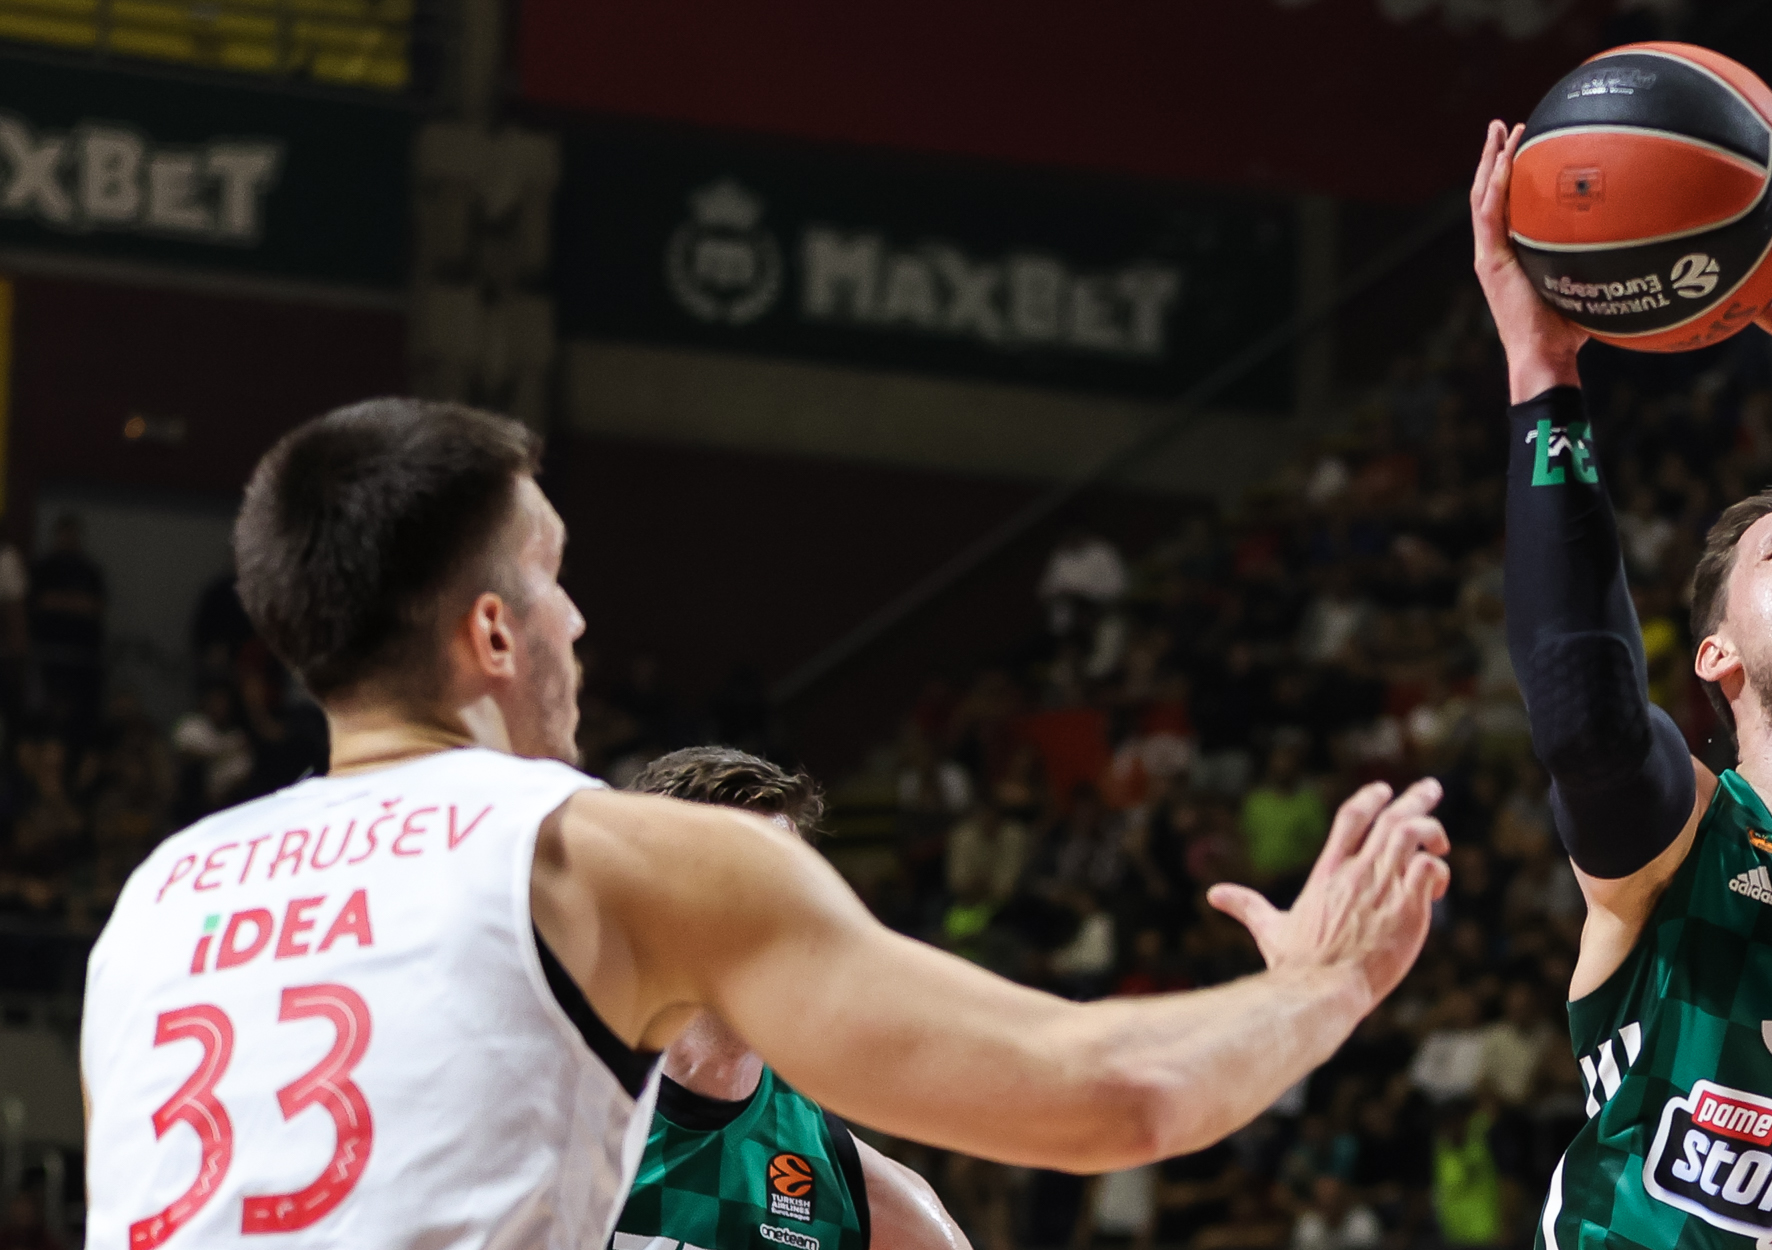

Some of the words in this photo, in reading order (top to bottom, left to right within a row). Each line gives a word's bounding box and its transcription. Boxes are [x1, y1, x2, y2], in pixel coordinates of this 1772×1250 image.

[803, 230, 1180, 352] MAXBET
[155, 796, 494, 903] PETRUŠEV
[771, 1193, 811, 1206] TURKISH
[771, 1201, 811, 1215] AIRLINES
